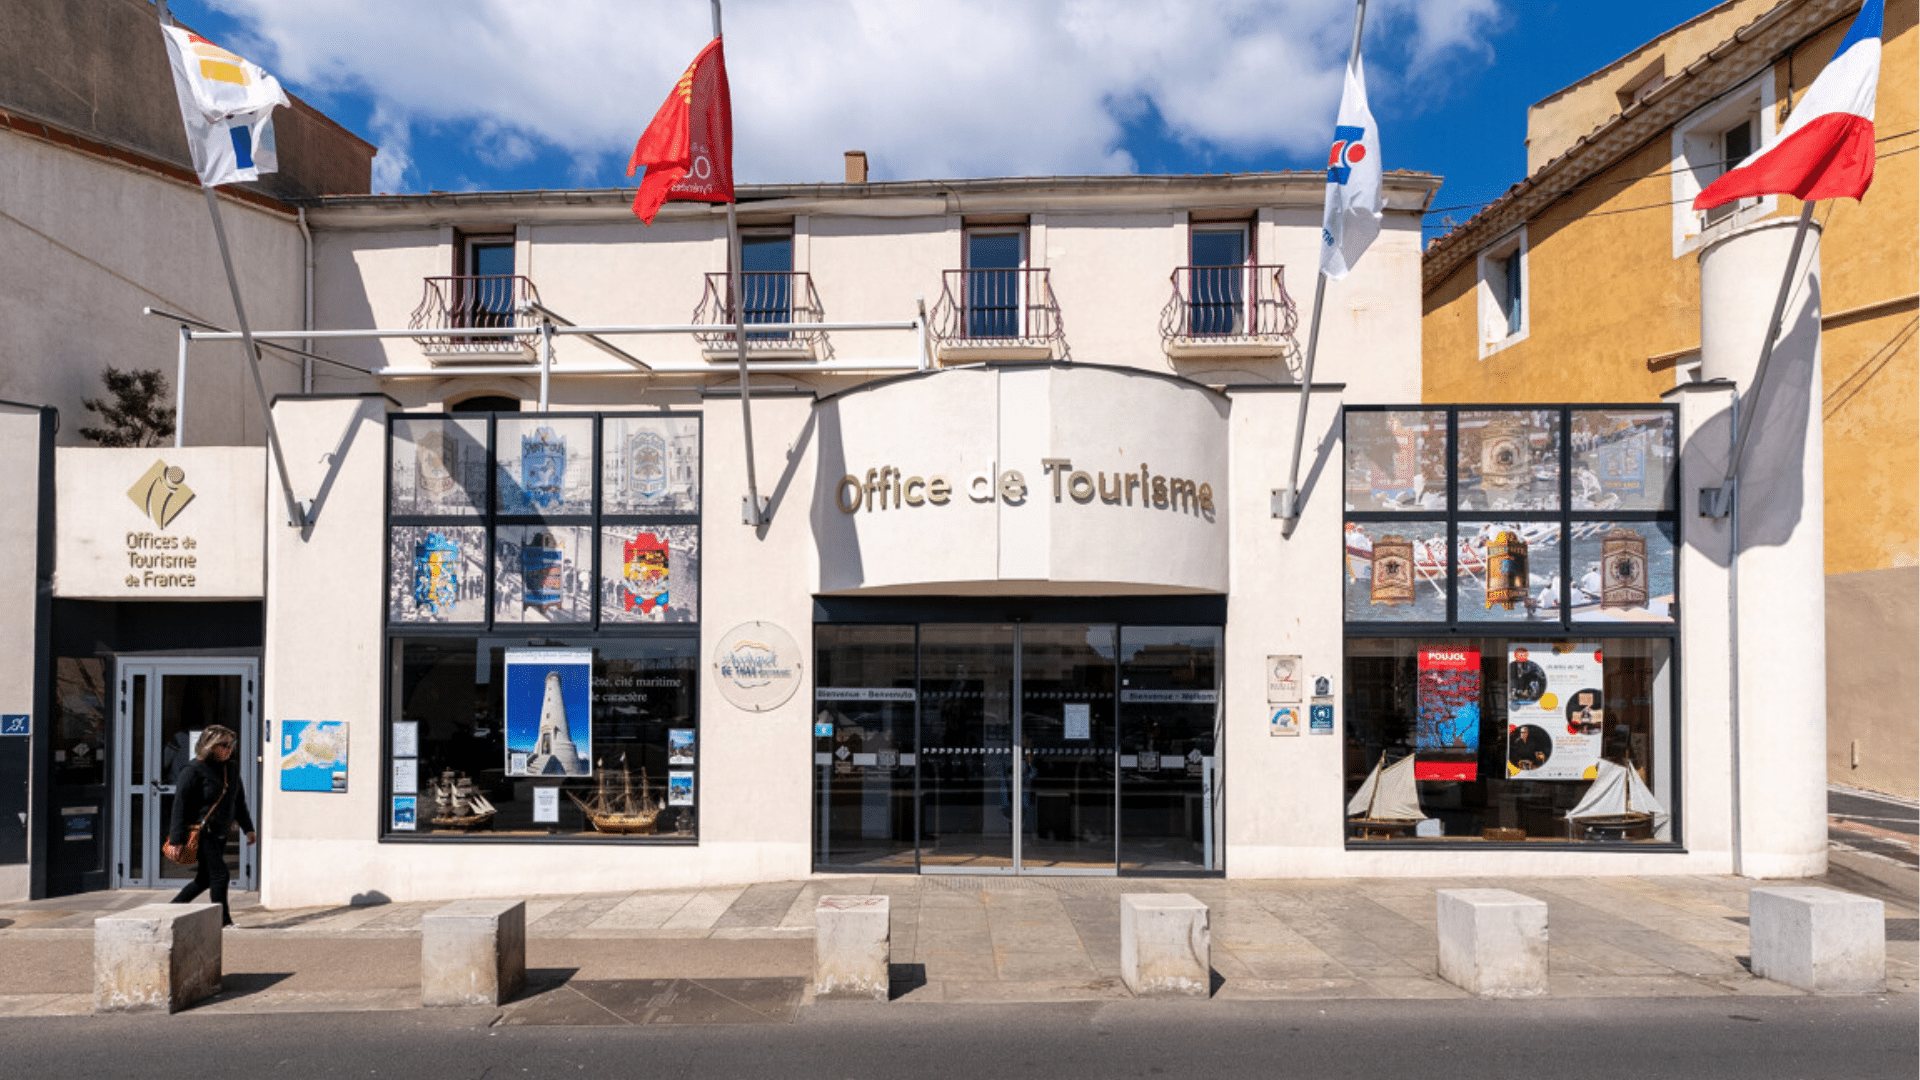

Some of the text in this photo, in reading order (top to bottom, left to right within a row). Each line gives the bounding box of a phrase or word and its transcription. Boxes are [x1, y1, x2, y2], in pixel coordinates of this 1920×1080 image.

[835, 458, 1214, 518] Office de Tourisme
[126, 531, 197, 549] Offices de
[127, 551, 197, 568] Tourisme
[125, 570, 196, 587] de France
[1428, 652, 1466, 661] POUJOL
[614, 676, 634, 687] cité
[636, 676, 682, 687] maritime
[601, 691, 647, 702] caractère
[817, 690, 860, 699] Bienvenue
